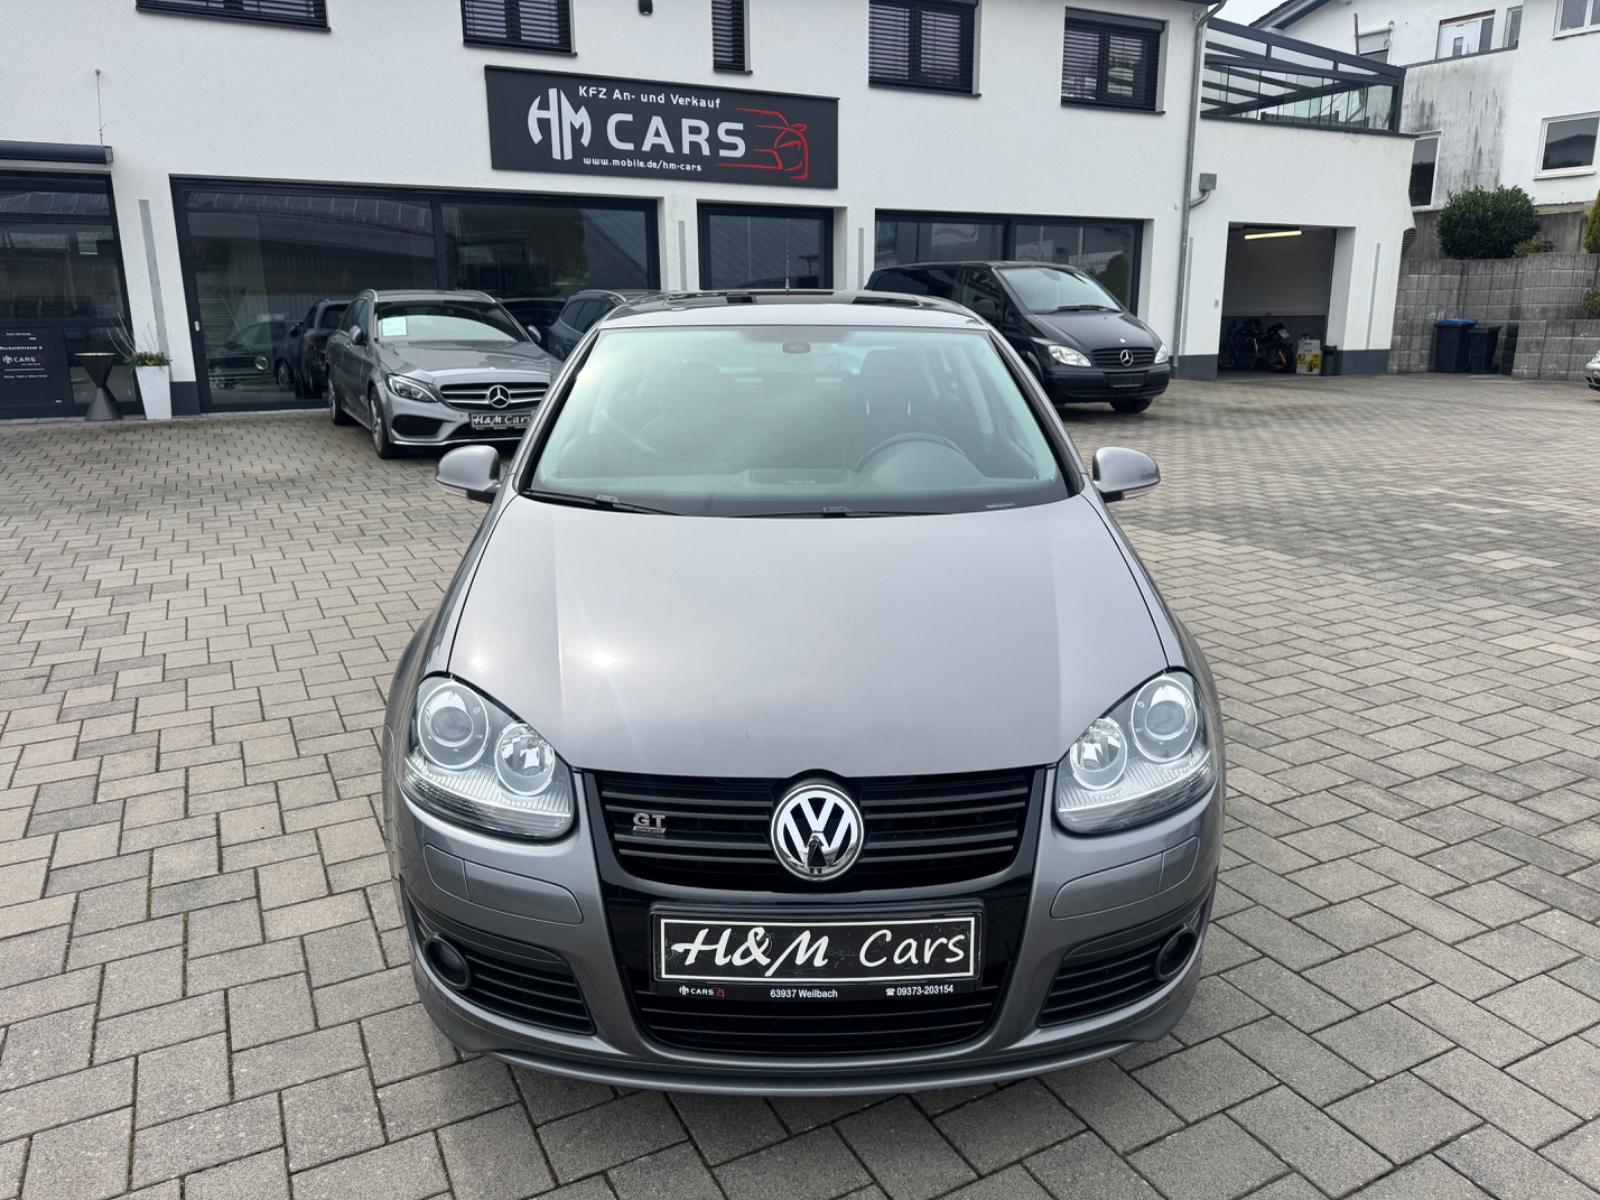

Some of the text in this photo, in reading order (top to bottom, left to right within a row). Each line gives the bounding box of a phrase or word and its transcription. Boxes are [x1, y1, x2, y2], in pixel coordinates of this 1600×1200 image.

[579, 86, 720, 109] KFZ An- und Verkauf
[607, 112, 746, 158] CARS
[583, 157, 702, 172] www.mobile.de/hm-cars
[633, 812, 666, 828] GT
[670, 926, 965, 977] H&M Cars
[690, 988, 714, 996] CARS
[770, 988, 838, 998] 63937 Weilbach
[896, 984, 954, 996] 09373-203154
